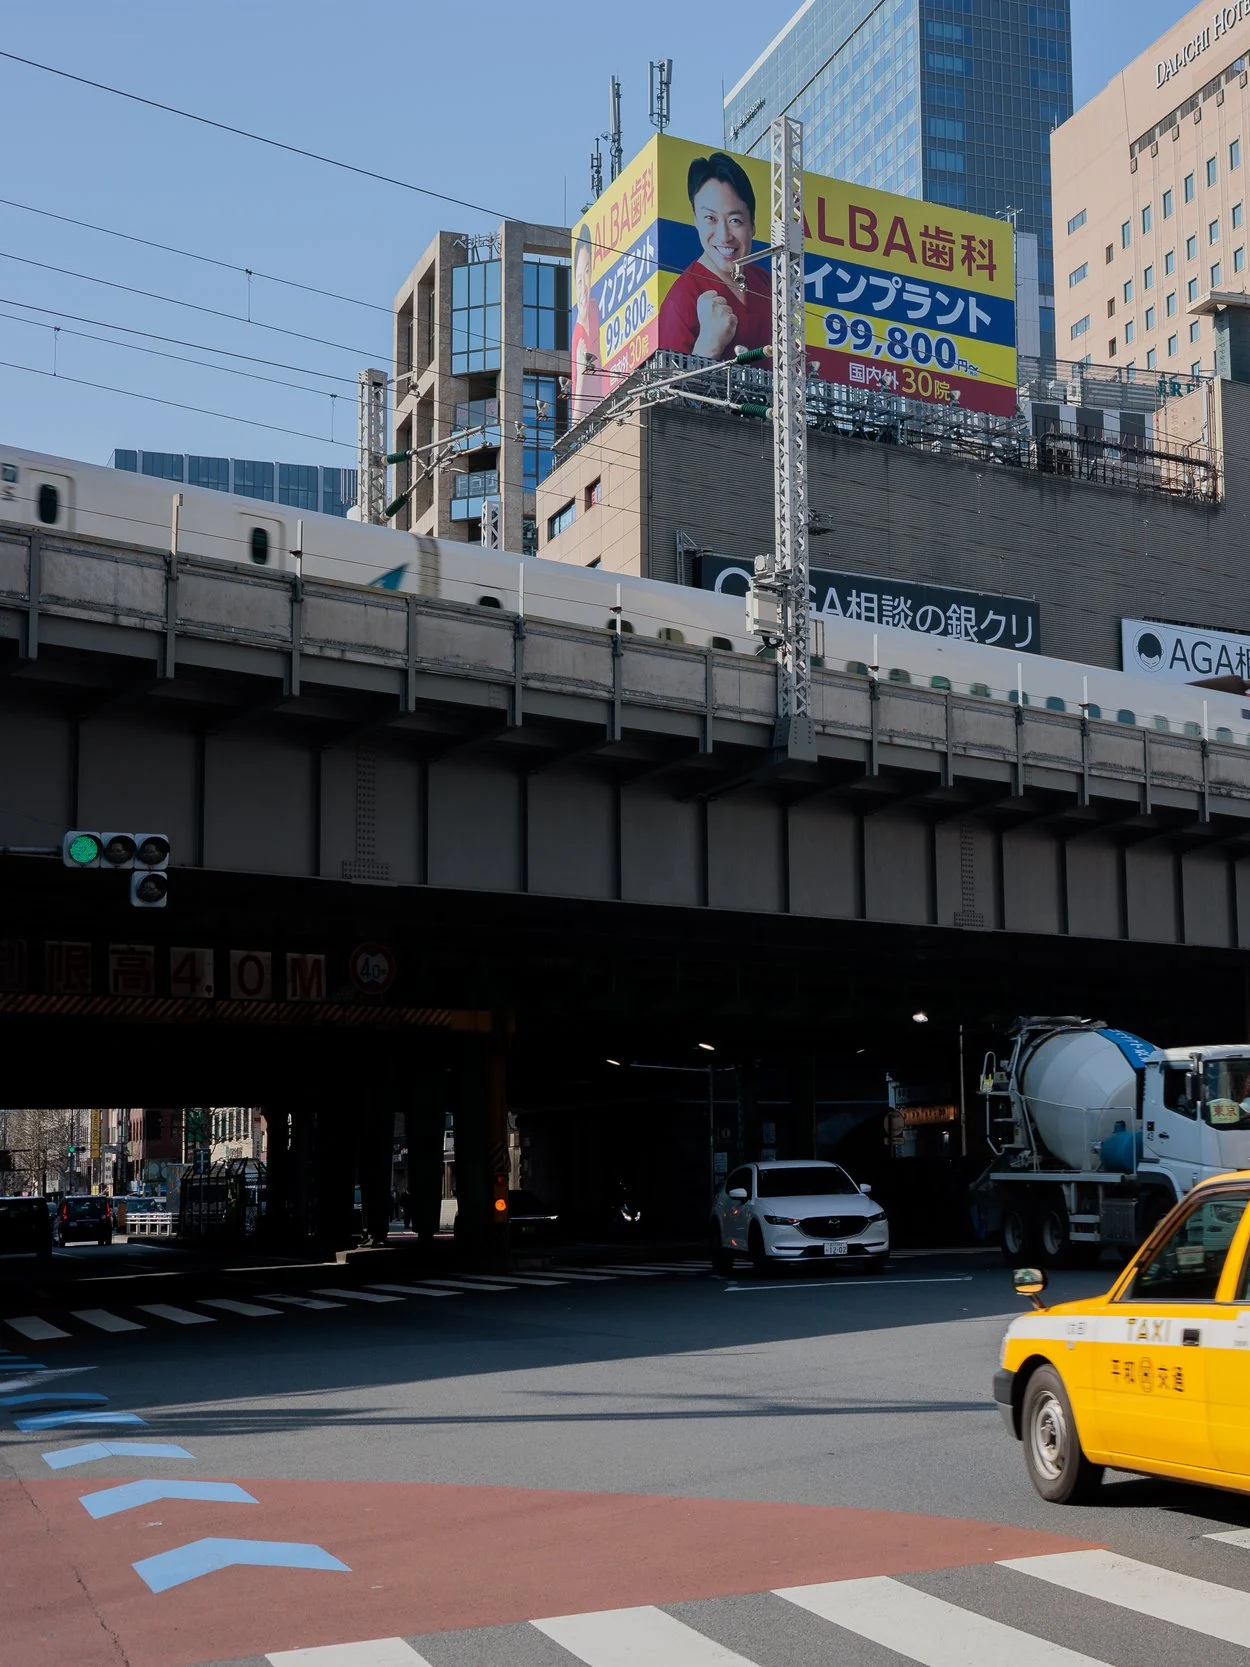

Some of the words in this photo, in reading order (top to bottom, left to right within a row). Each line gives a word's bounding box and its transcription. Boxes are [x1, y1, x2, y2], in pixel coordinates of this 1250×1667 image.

[1155, 28, 1211, 88] DAI-ICHI
[594, 161, 655, 269] ALBA歯科
[598, 234, 655, 319] インプラント
[804, 262, 993, 334] インプラント
[1212, 1104, 1237, 1117] 東京
[1127, 1318, 1173, 1342] TAXI
[1111, 1359, 1135, 1384] 平和
[1157, 1366, 1185, 1392] 交通
